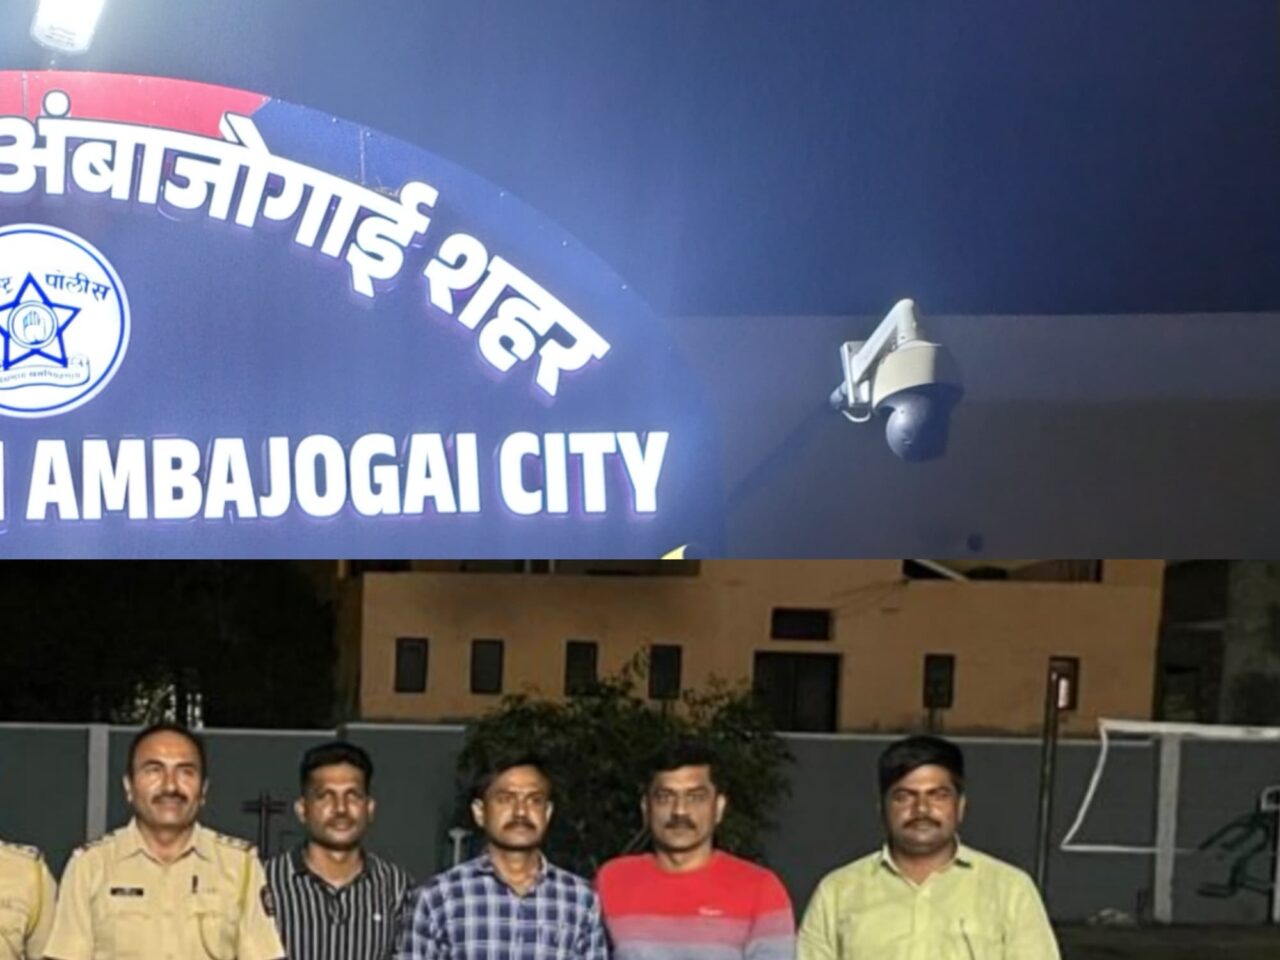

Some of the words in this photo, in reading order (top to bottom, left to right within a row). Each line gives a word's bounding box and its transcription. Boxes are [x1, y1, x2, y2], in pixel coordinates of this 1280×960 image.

[425, 233, 611, 396] शहर
[26, 432, 481, 522] AMBAJOGAI
[499, 430, 669, 515] CITY
